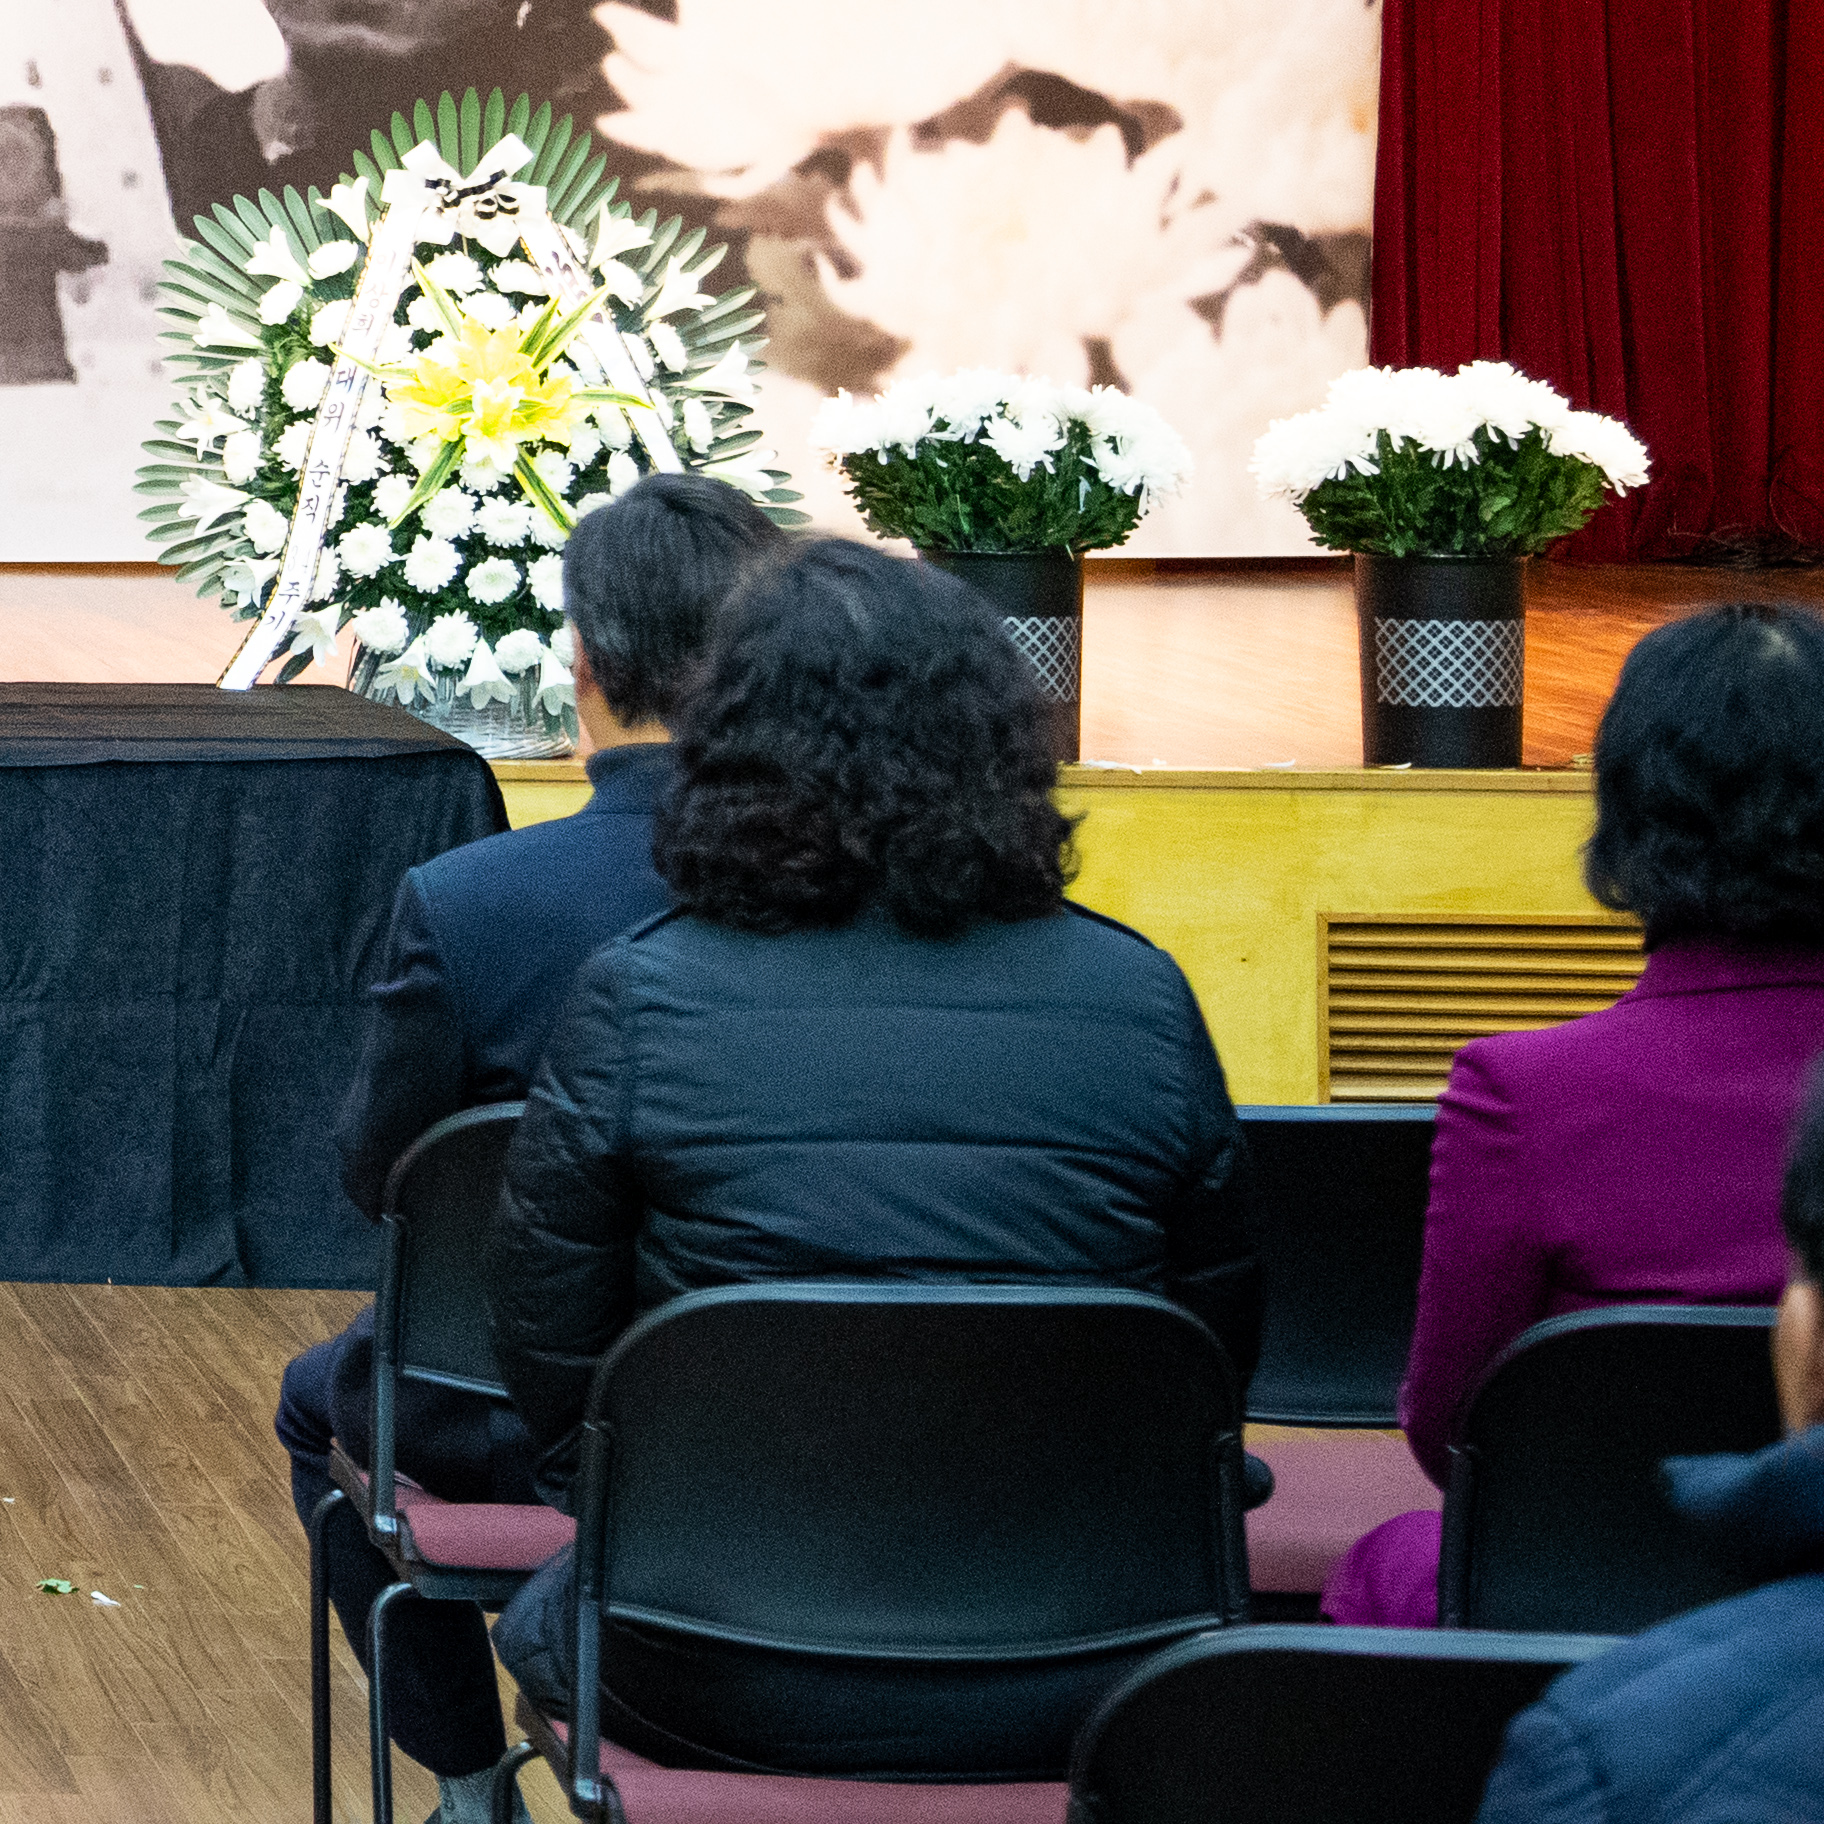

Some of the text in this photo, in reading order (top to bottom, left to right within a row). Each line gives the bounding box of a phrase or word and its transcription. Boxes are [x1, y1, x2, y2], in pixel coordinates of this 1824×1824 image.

[352, 250, 397, 337] 이상희
[323, 366, 358, 433] 대위
[301, 458, 331, 524] 순직
